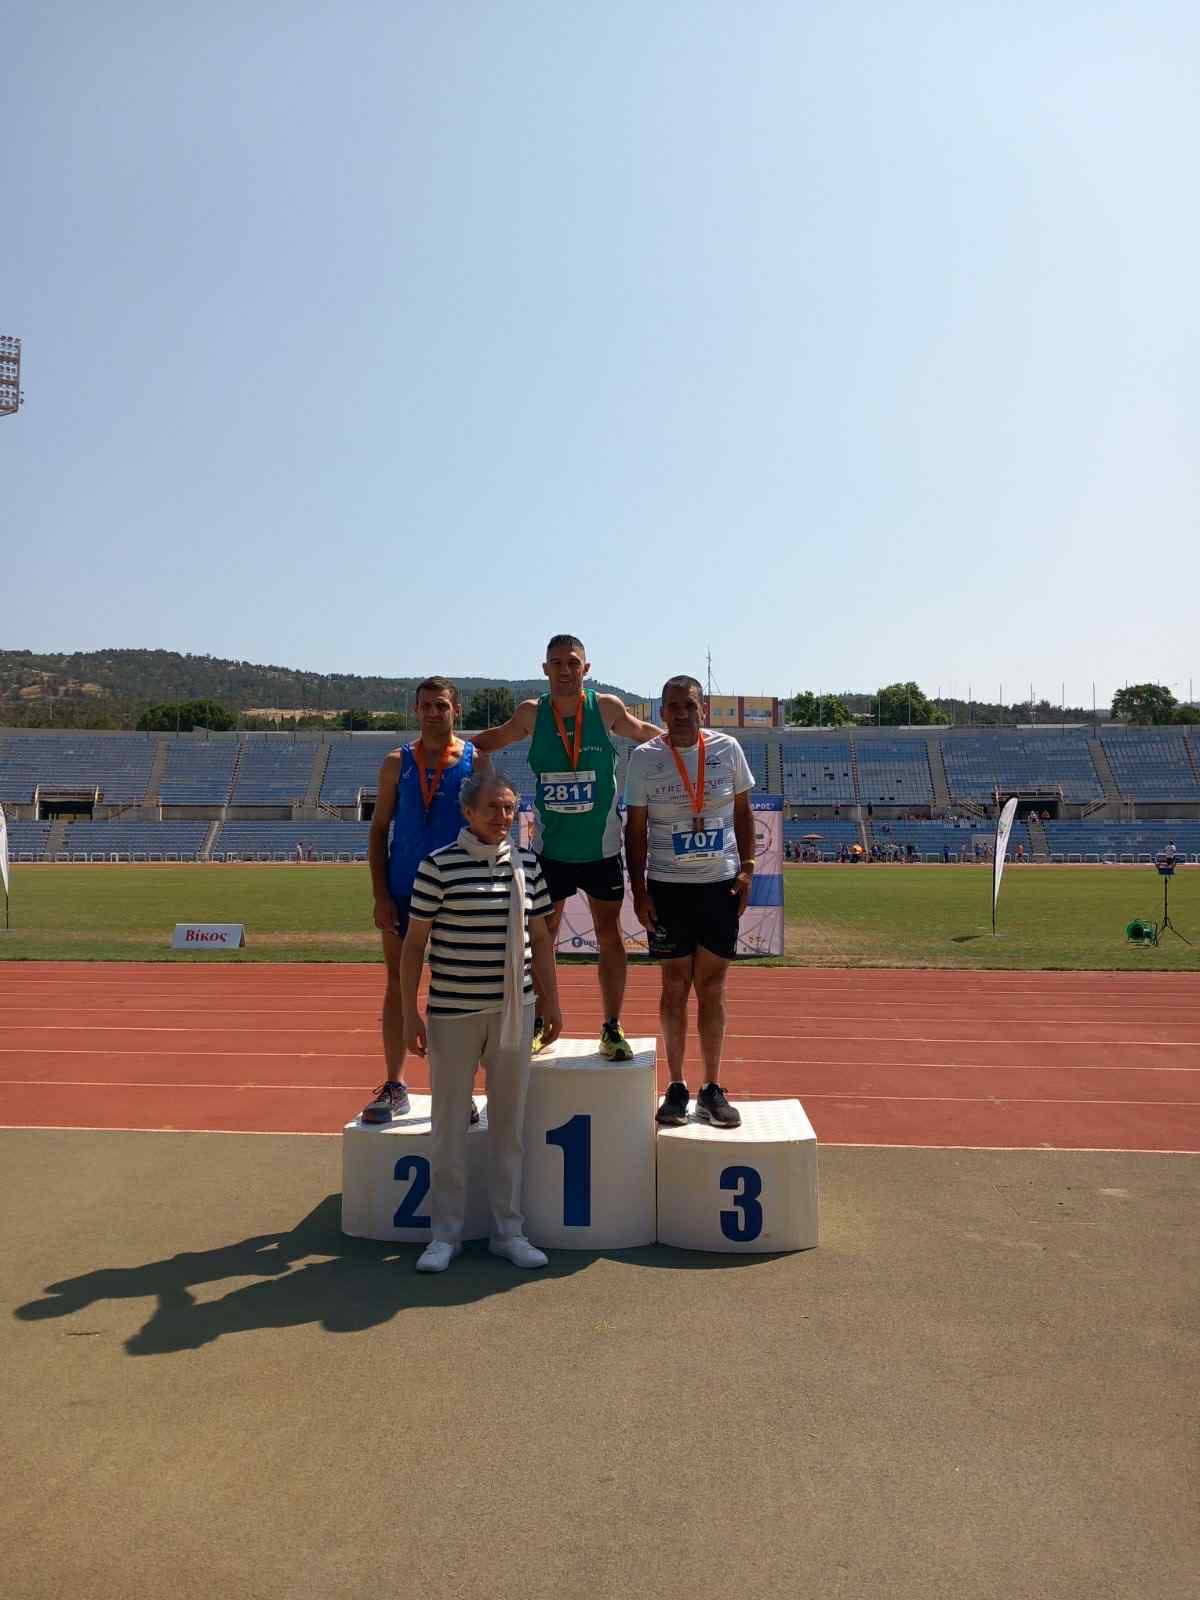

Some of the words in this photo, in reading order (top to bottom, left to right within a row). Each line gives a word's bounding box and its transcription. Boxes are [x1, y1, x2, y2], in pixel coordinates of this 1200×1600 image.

[543, 784, 593, 801] 2811
[680, 831, 718, 849] 707
[393, 1155, 431, 1228] 2
[546, 1114, 592, 1227] 1
[719, 1165, 763, 1243] 3
